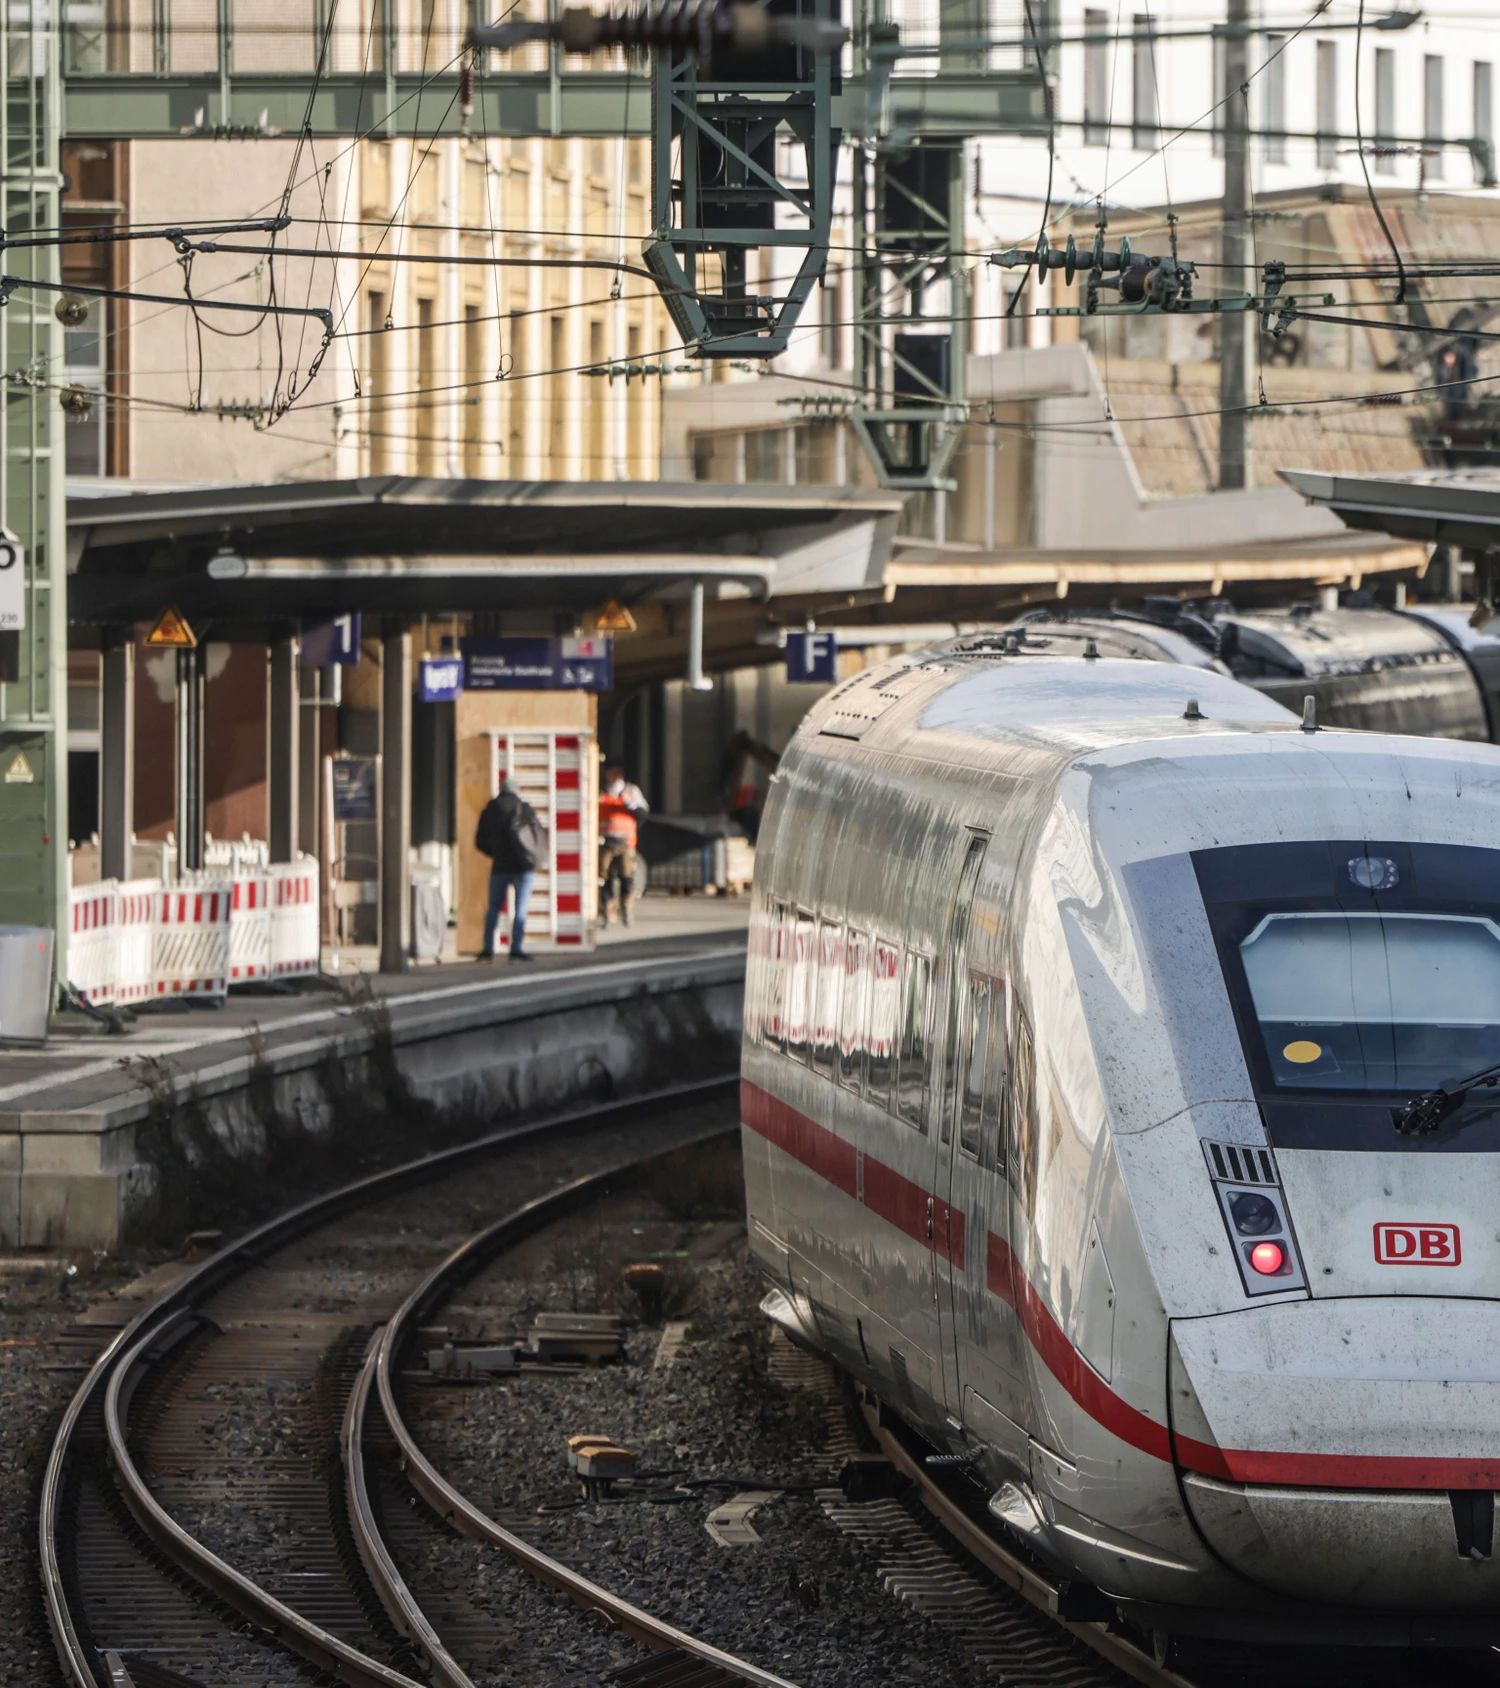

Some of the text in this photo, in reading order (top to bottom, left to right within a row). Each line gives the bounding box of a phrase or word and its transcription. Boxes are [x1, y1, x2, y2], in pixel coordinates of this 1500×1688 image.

[334, 613, 351, 653] 1
[805, 634, 829, 672] F
[1385, 1229, 1451, 1259] DB
